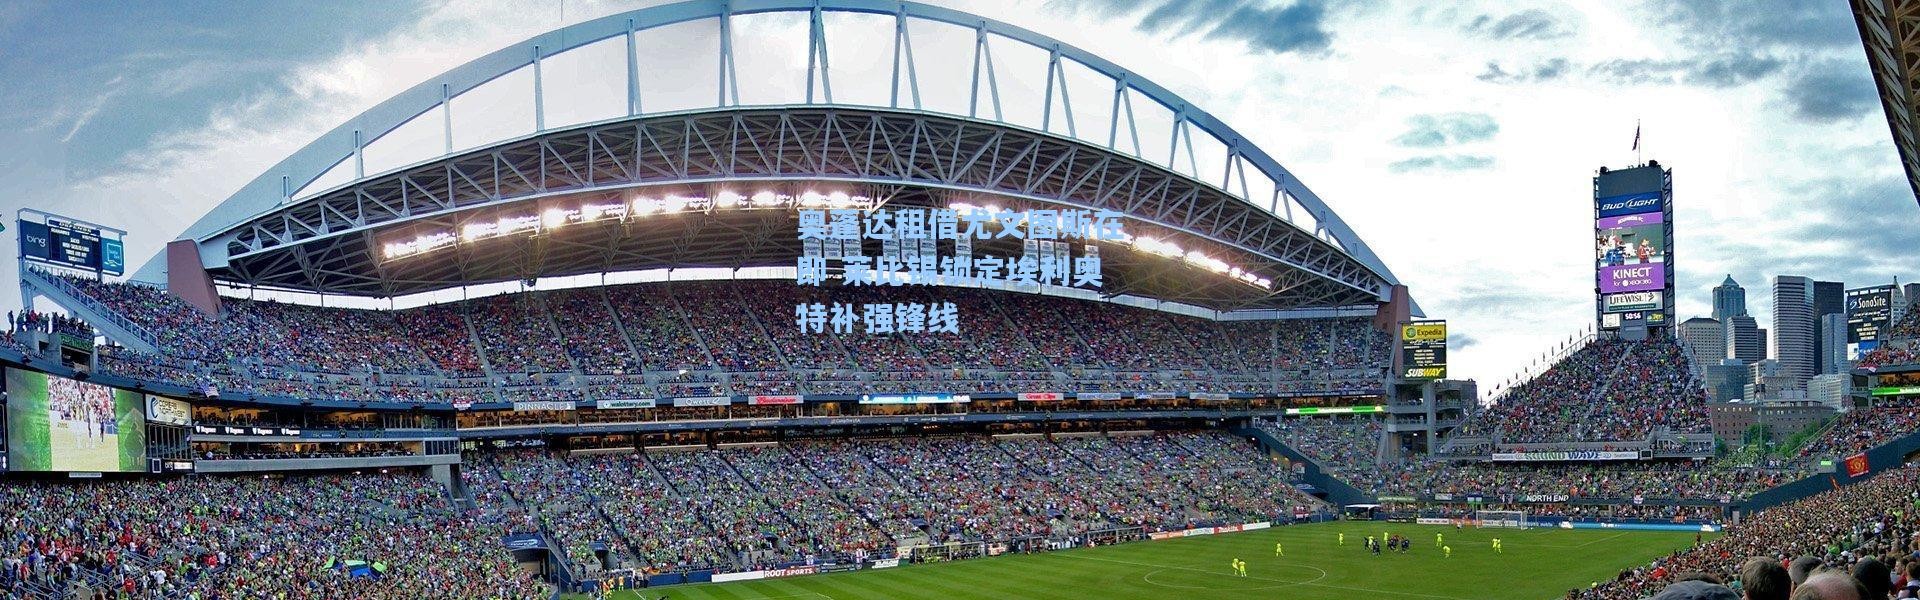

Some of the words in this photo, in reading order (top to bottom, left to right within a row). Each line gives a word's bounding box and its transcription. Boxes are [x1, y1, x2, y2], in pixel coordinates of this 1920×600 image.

[1602, 202, 1624, 210] BUD
[1628, 198, 1658, 207] LIGHT
[26, 234, 46, 248] bing
[1613, 267, 1653, 279] KINECT
[1858, 296, 1886, 308] SonoSite
[1405, 368, 1444, 377] SUBWAY
[518, 401, 565, 410] PINNACLE
[1553, 494, 1569, 502] END
[764, 569, 786, 577] ROOT
[787, 567, 814, 576] SPORTS
